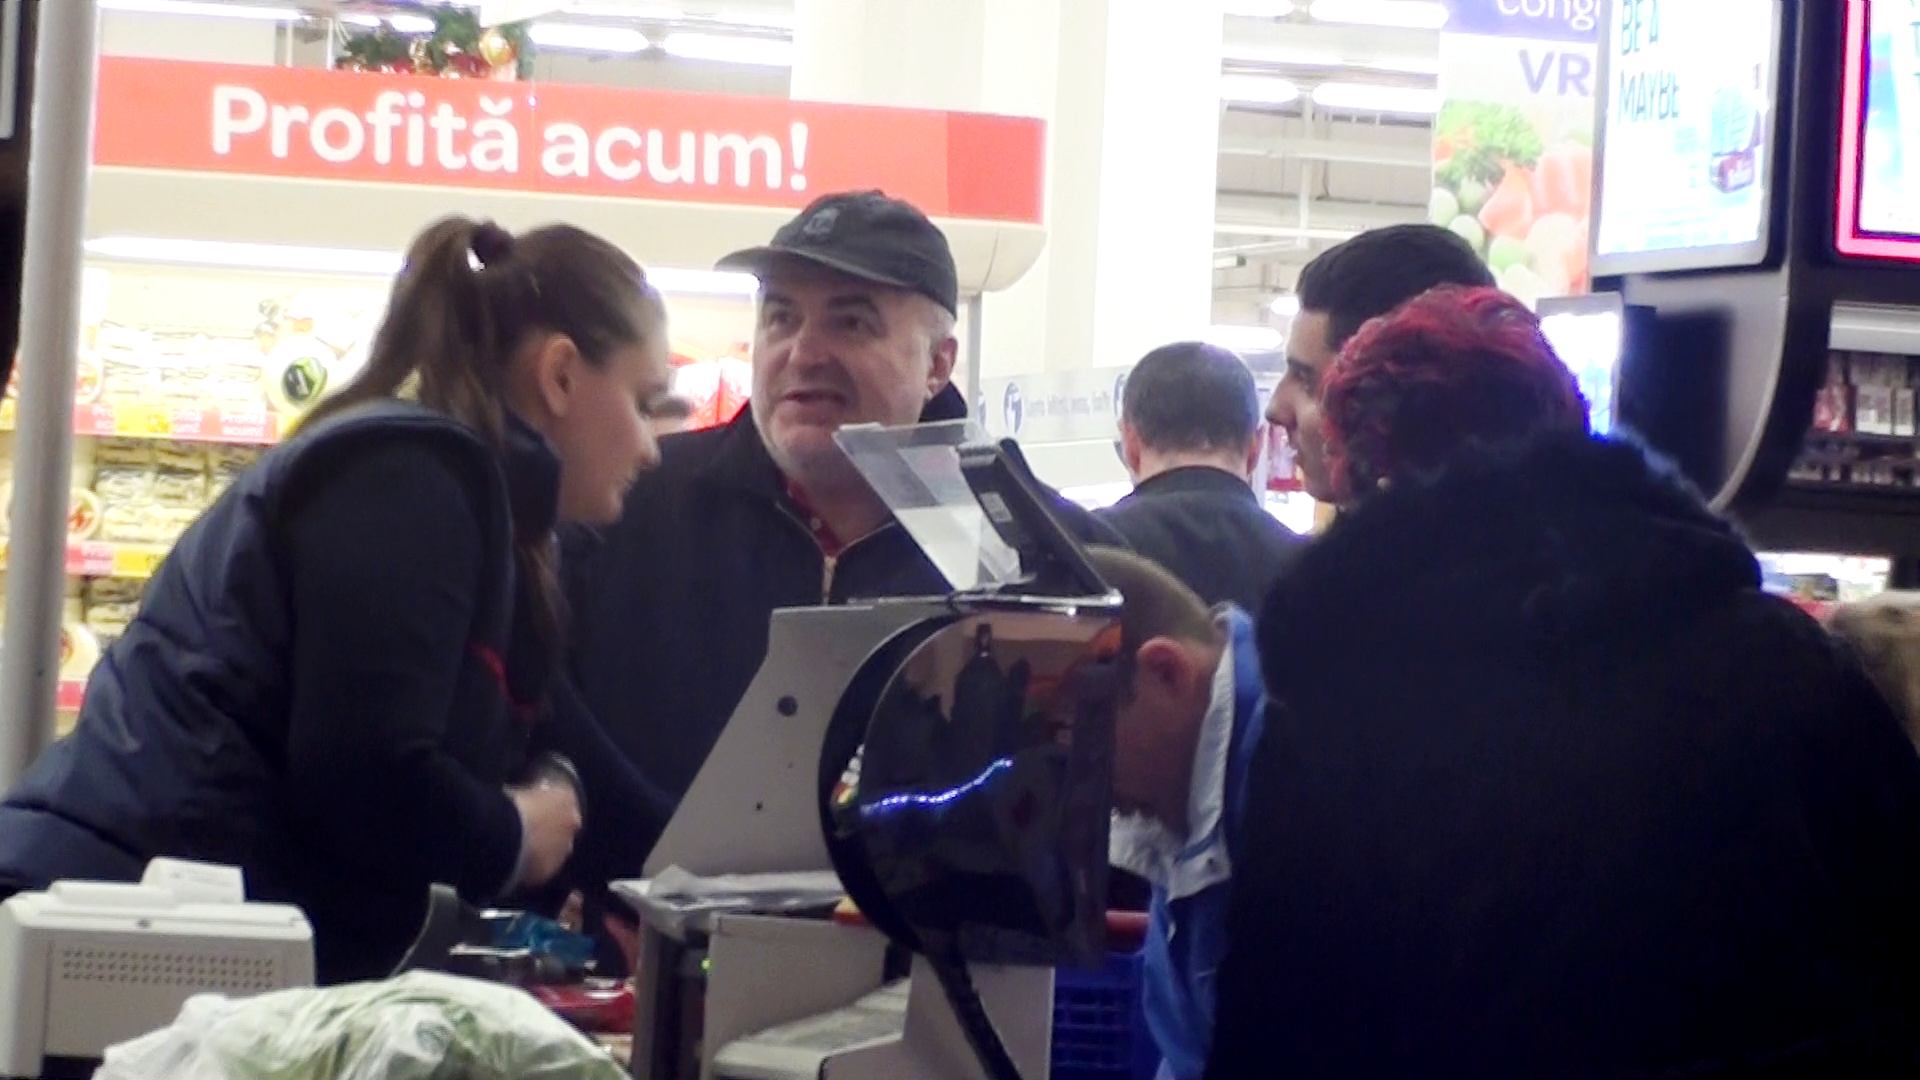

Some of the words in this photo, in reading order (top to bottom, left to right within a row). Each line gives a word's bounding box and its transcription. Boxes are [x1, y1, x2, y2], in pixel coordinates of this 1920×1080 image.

[1621, 0, 1642, 56] BE
[1517, 48, 1594, 98] VR
[1617, 69, 1681, 125] MAYBE
[211, 84, 518, 174] Profită
[541, 121, 808, 192] acum!
